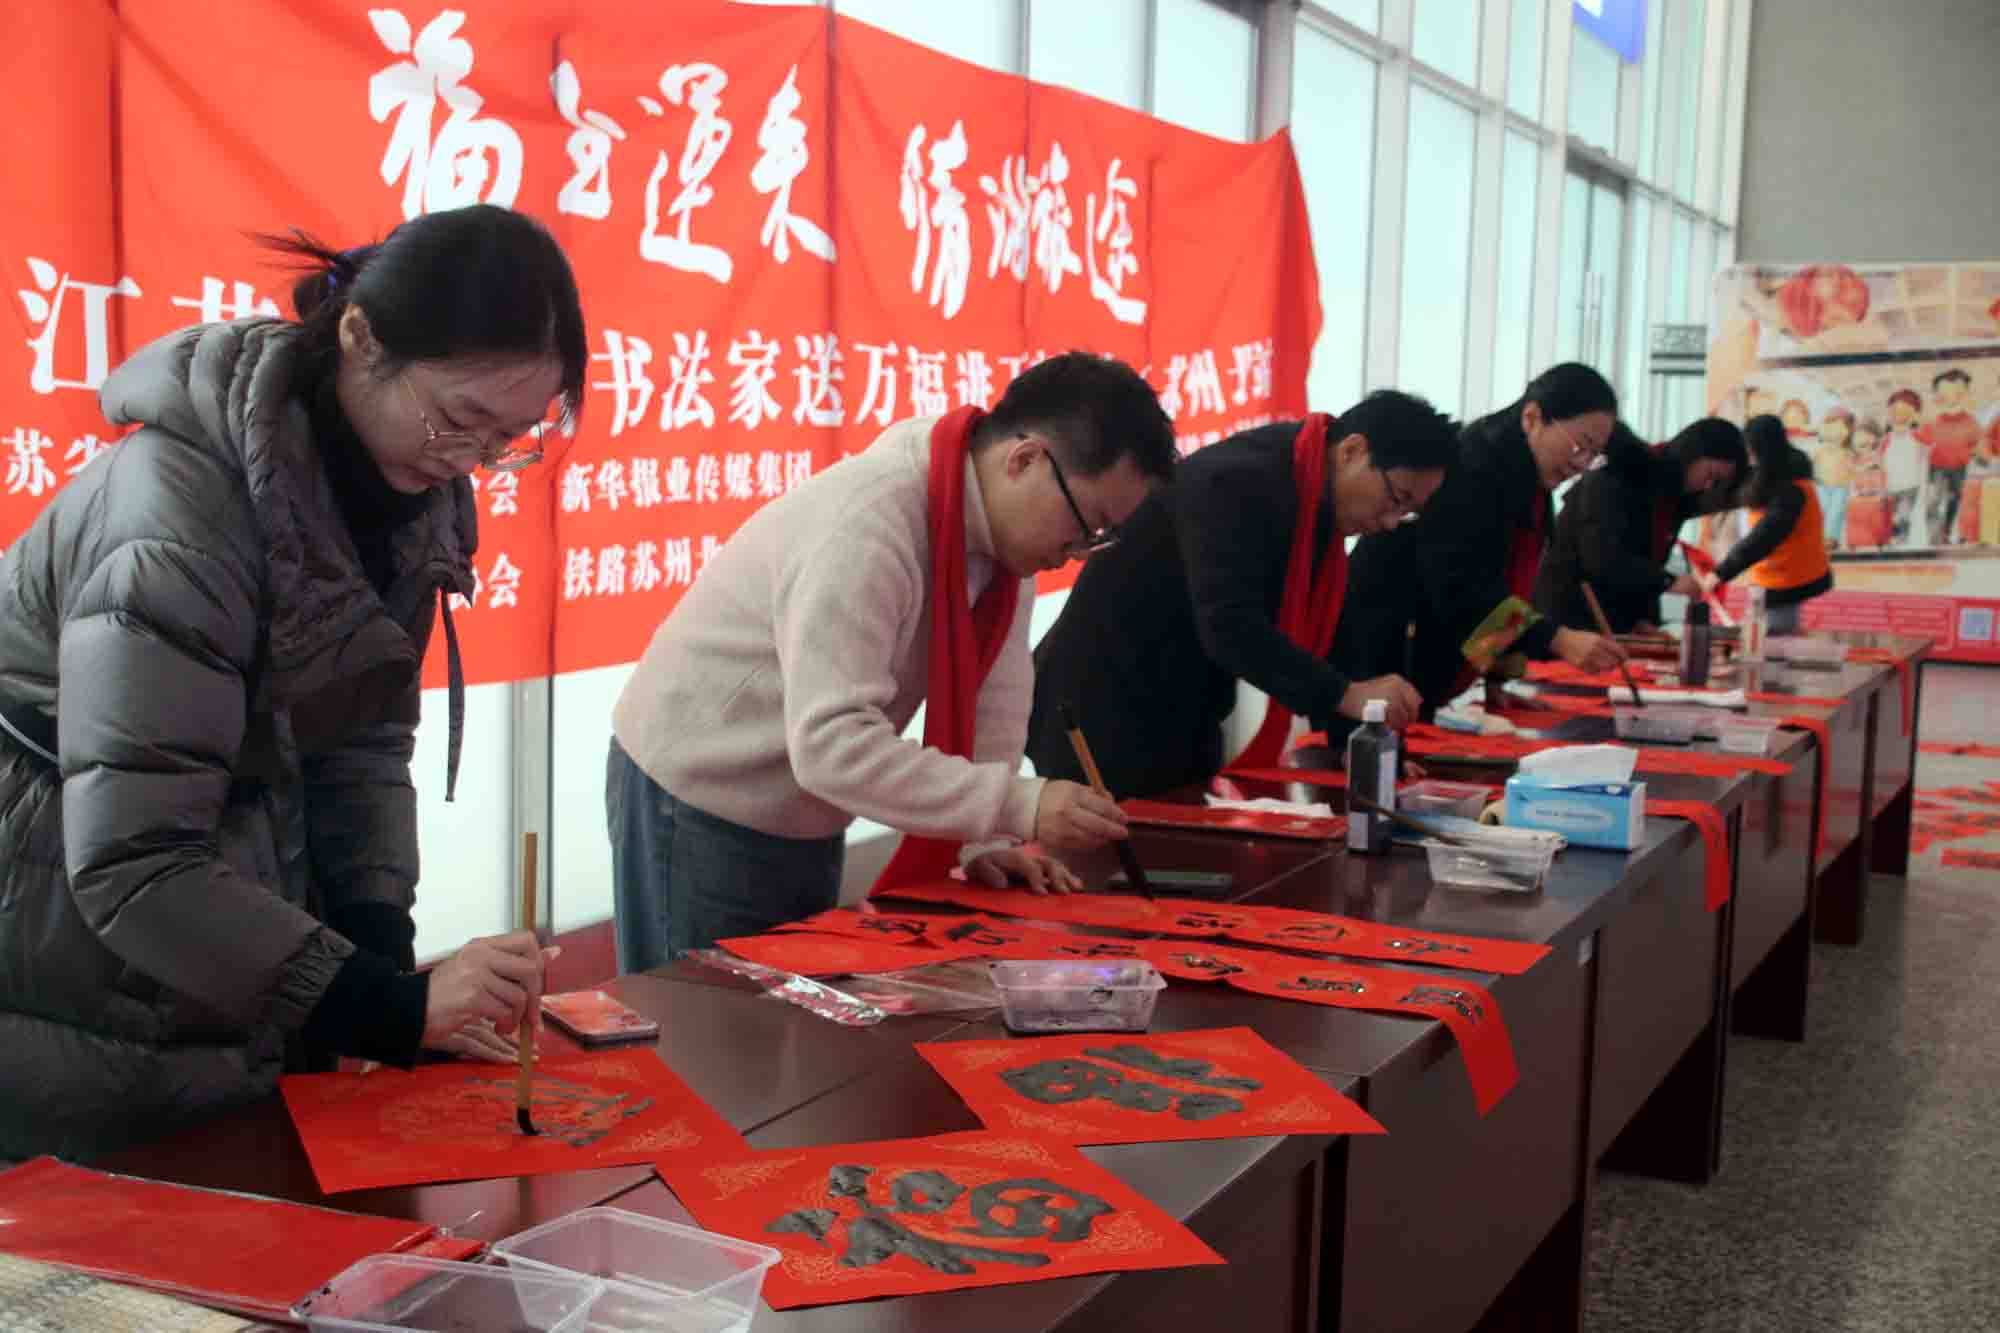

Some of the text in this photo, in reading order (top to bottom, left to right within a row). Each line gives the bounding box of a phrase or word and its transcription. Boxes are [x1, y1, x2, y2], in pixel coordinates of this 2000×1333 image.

[561, 450, 813, 513] 新华报业传媒集团
